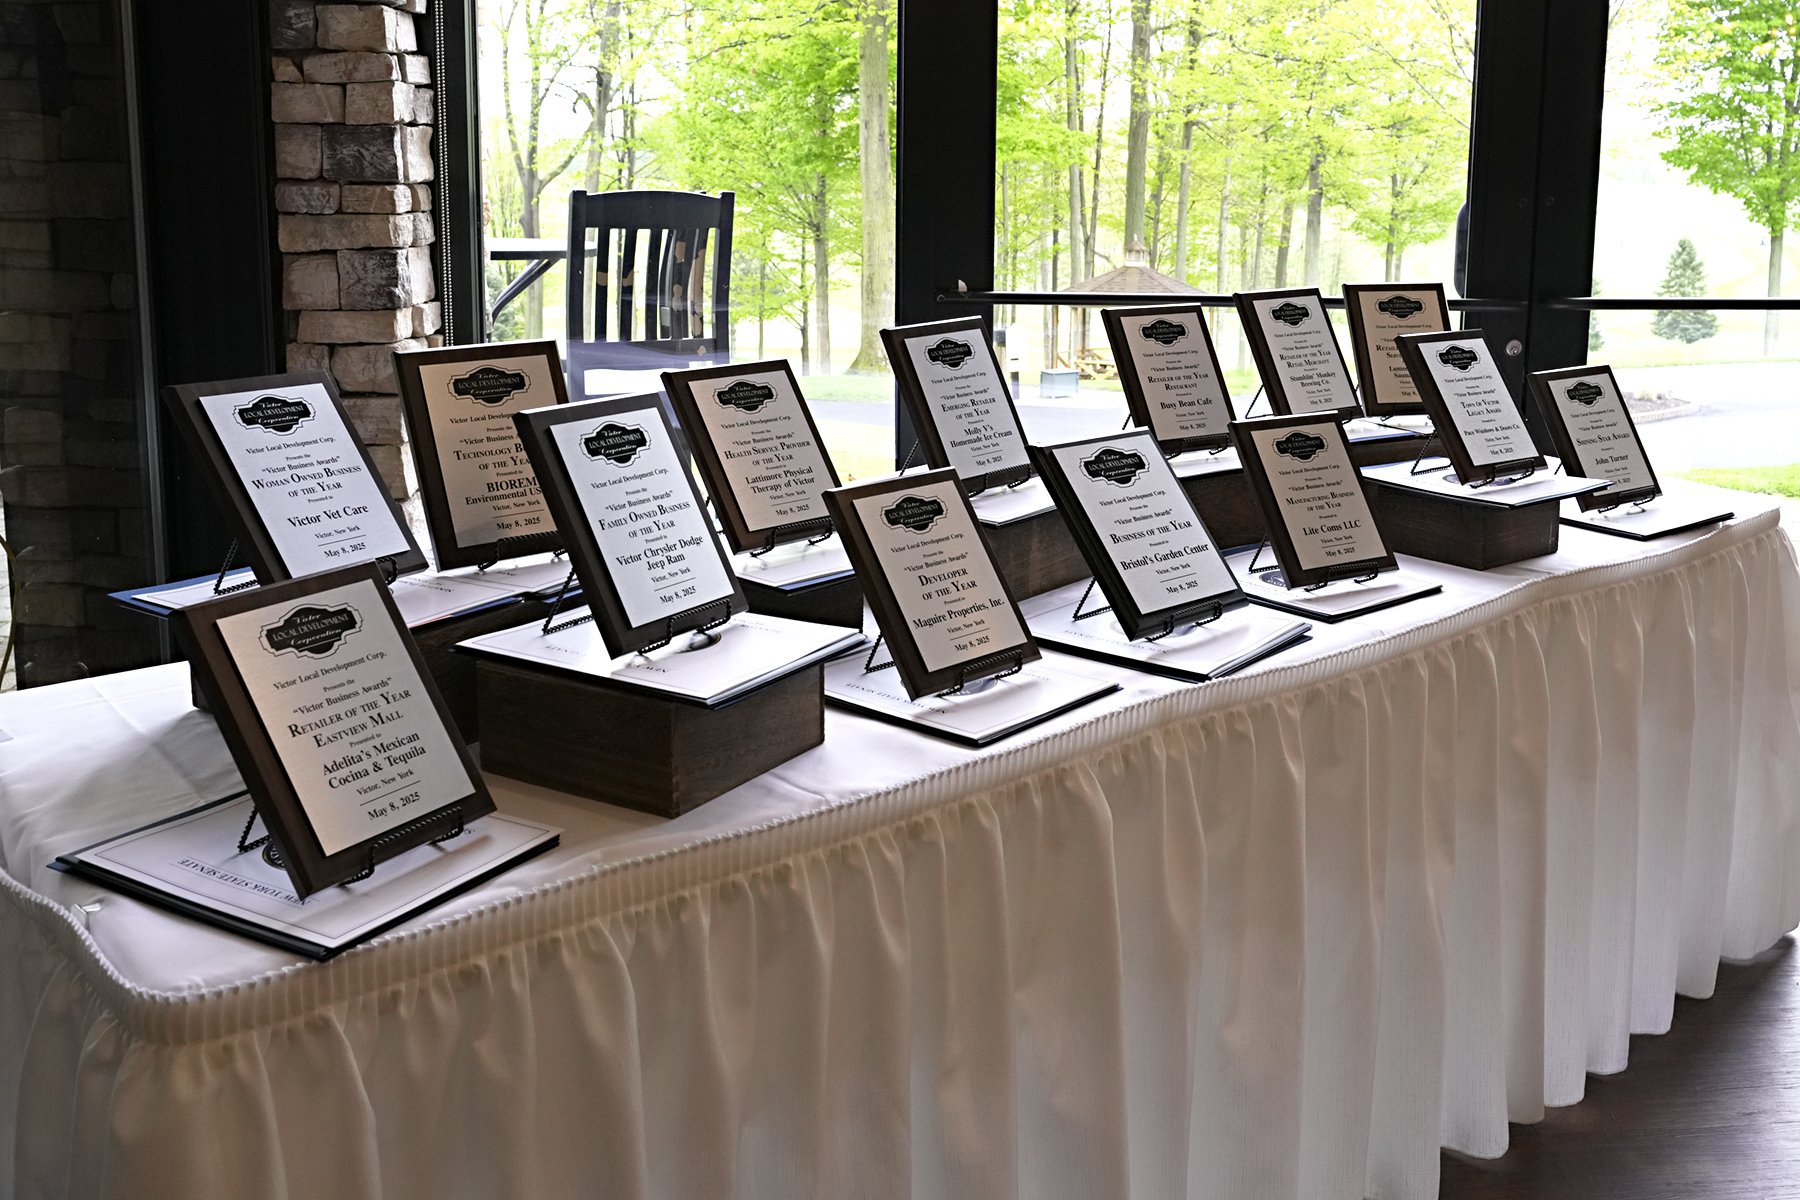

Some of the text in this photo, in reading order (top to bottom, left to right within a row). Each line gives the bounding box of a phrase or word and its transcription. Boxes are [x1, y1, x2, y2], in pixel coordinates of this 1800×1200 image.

[453, 448, 511, 460] TECHNOLOGY
[724, 441, 810, 459] HEALTH SERVICE PROVIDER
[774, 453, 794, 462] YEAR
[287, 462, 315, 470] Business
[510, 453, 529, 466] YEA
[252, 467, 361, 489] WOMAN OWNED BUSINESS
[745, 466, 813, 484] Lattimore Physical
[316, 482, 342, 492] YEAR
[486, 476, 537, 493] BIOREM
[750, 478, 815, 494] Therapy of Victor
[465, 489, 527, 505] Environmental
[287, 506, 368, 527] Victor Vet Care
[496, 522, 512, 530] May
[524, 517, 540, 526] 2025
[598, 503, 690, 531] FAMILY OWNED BUSINESS
[628, 520, 676, 538] OF THE YEAR
[1110, 532, 1146, 544] BUSINESS
[1169, 520, 1192, 530] YEAR
[350, 542, 366, 552] 2025
[616, 536, 703, 566] Victor Chrysler Dodge
[1154, 550, 1184, 562] Garden
[1184, 544, 1209, 555] Center
[647, 554, 686, 571] Jeep Ram
[918, 568, 968, 586] DEVELOPER
[660, 595, 674, 604] May
[682, 586, 696, 597] 2025
[922, 580, 977, 600] OF THE YEAR
[293, 615, 320, 623] Victor
[913, 599, 1005, 629] Maguire Properties, Inc.
[273, 614, 348, 641] LOCAL DEVELOPMENT
[273, 652, 387, 690] Victor Local Development Corp.
[323, 682, 346, 692] Presents
[325, 691, 360, 706] Business
[288, 690, 411, 738] RETAILER OF THE YEAR
[313, 711, 404, 748] EASTVIEW MALL
[349, 734, 376, 748] Presented
[324, 733, 420, 776] Adelita's Mexican
[329, 746, 426, 789] Cocina & Tequila
[356, 769, 414, 795] Victor, New York
[368, 792, 420, 820] May 8, 2025
